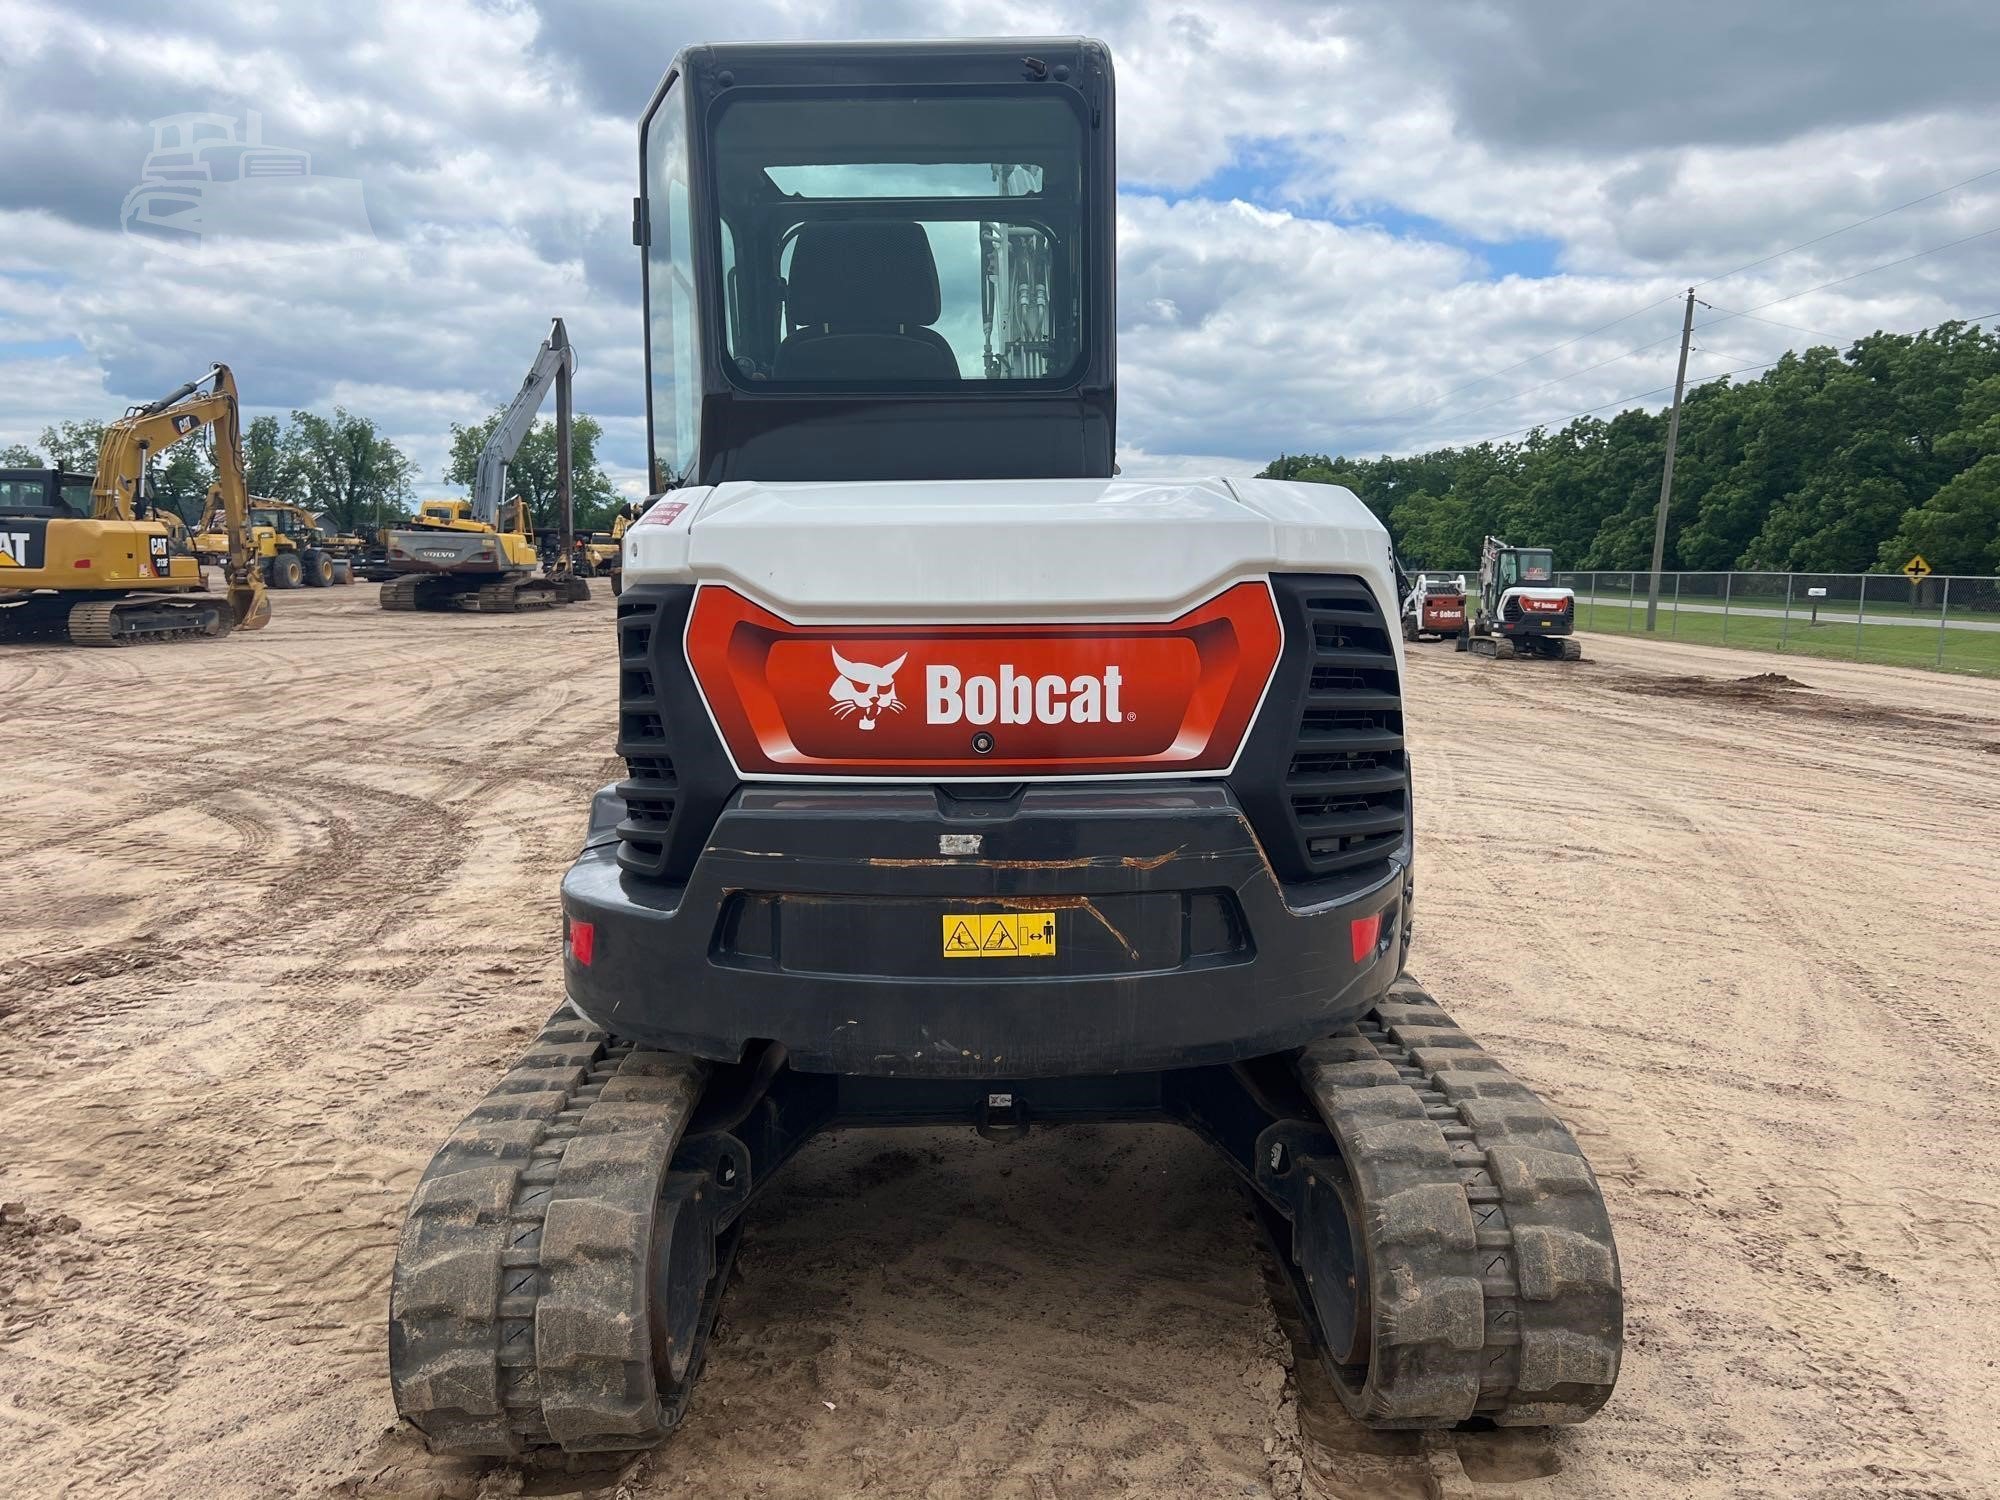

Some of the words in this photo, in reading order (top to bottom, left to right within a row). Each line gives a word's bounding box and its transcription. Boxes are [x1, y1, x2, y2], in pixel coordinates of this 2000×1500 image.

[178, 415, 192, 433] CAT
[0, 532, 30, 567] AT
[150, 537, 167, 555] CAT
[1439, 610, 1461, 618] Bobcat
[926, 664, 1123, 725] Bobcat
